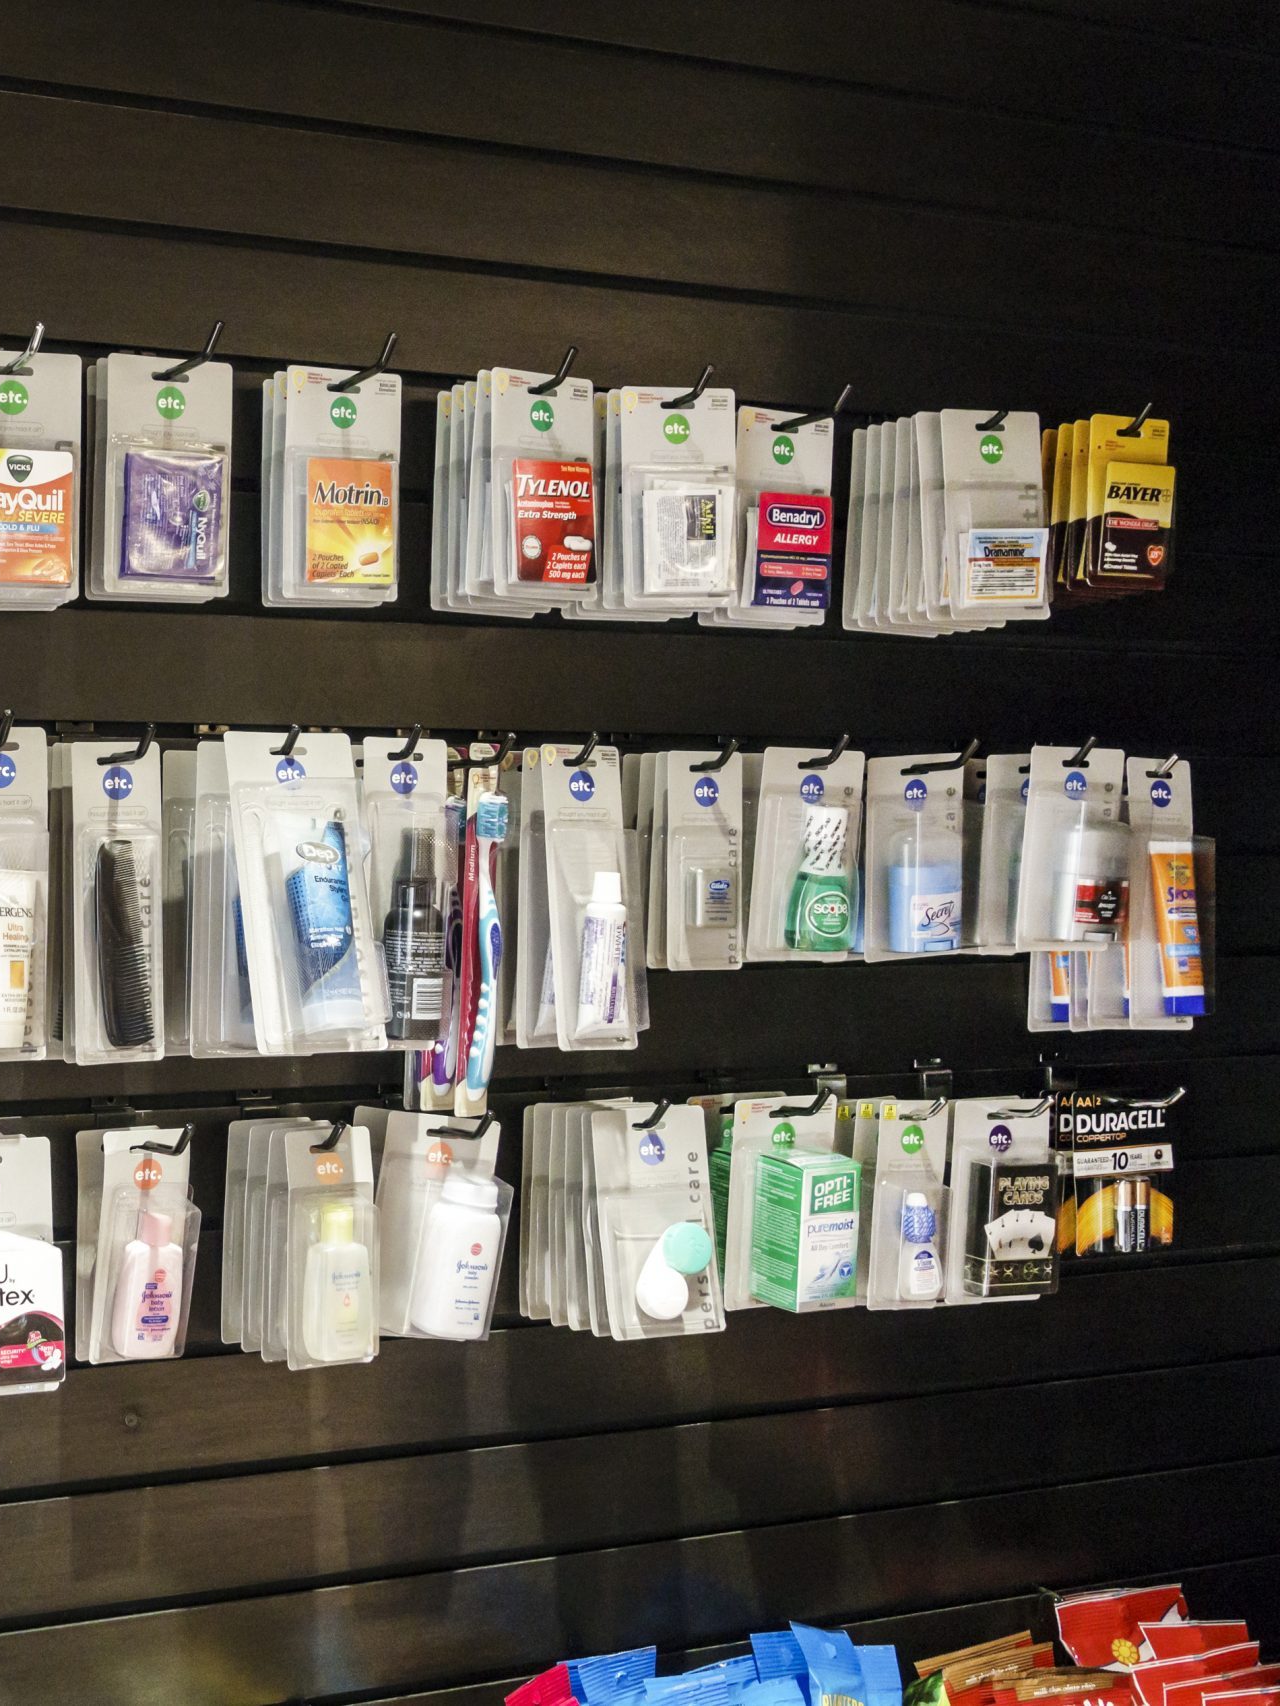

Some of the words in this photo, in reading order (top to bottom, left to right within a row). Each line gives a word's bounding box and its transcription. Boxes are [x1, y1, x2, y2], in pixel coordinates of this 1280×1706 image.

[157, 397, 186, 411] etc.
[331, 406, 357, 420] etc.
[531, 409, 555, 423] etc.
[664, 423, 691, 436] etc.
[773, 444, 795, 457] etc.
[981, 443, 1004, 456] etc.
[8, 463, 31, 471] VICKS
[516, 474, 591, 498] TYLENOL
[313, 481, 382, 506] Motrin
[381, 497, 389, 506] IB
[1107, 485, 1162, 503] BAYER
[18, 511, 65, 524] SEVERE
[517, 510, 540, 519] Extra
[542, 510, 577, 521] Strength
[771, 508, 820, 528] Benadryl
[26, 524, 40, 532] FLU
[195, 516, 208, 560] NyQuil
[773, 533, 819, 546] ALLERGY
[312, 553, 317, 561] 2
[552, 552, 557, 561] 2
[557, 553, 580, 561] Pouches
[580, 553, 588, 561] of
[984, 546, 1026, 558] Dramamine
[312, 562, 319, 570] of
[325, 562, 349, 570] Coated
[546, 562, 551, 570] 2
[551, 562, 573, 571] Caplets
[573, 562, 587, 570] each
[339, 570, 355, 578] Each
[548, 570, 562, 579] 500
[561, 572, 571, 580] mg
[571, 571, 585, 579] each
[277, 767, 307, 781] etc.
[391, 771, 419, 787] etc.
[104, 777, 134, 790] etc.
[569, 779, 596, 793] etc.
[800, 783, 825, 796] etc.
[1065, 780, 1088, 792] etc.
[695, 786, 720, 799] etc.
[905, 787, 928, 800] etc.
[1151, 787, 1172, 801] etc.
[302, 842, 335, 862] Dep
[728, 828, 738, 868] care
[140, 874, 152, 929] care
[813, 903, 848, 917] scope
[920, 900, 955, 928] Secret
[7, 923, 24, 931] Ultra
[2, 932, 29, 941] Healing
[614, 933, 622, 962] WHITE
[1076, 1096, 1092, 1108] AA
[1096, 1096, 1102, 1106] 2
[1076, 1109, 1166, 1134] DURACELL
[772, 1131, 796, 1144] etc.
[902, 1133, 924, 1146] etc.
[990, 1132, 1012, 1145] etc.
[1076, 1132, 1127, 1143] COPPERTOP
[640, 1143, 666, 1156] etc.
[428, 1150, 452, 1165] etc.
[1076, 1156, 1109, 1165] GUARANTEED
[1111, 1151, 1129, 1171] 10
[1129, 1153, 1143, 1161] YEARS
[134, 1167, 162, 1182] etc.
[316, 1162, 345, 1176] etc.
[688, 1151, 700, 1204] care
[998, 1175, 1050, 1192] PLAYING
[814, 1175, 851, 1197] OPTI-
[814, 1187, 853, 1211] FREE
[1003, 1190, 1044, 1206] CARDS
[807, 1218, 854, 1238] puremoist
[1137, 1210, 1146, 1248] DURACELL
[456, 1260, 488, 1274] Johnson's
[142, 1290, 173, 1303] Johnson's
[1033, 1688, 1049, 1696] milk
[1049, 1684, 1080, 1695] chocolate
[1081, 1682, 1097, 1691] chip
